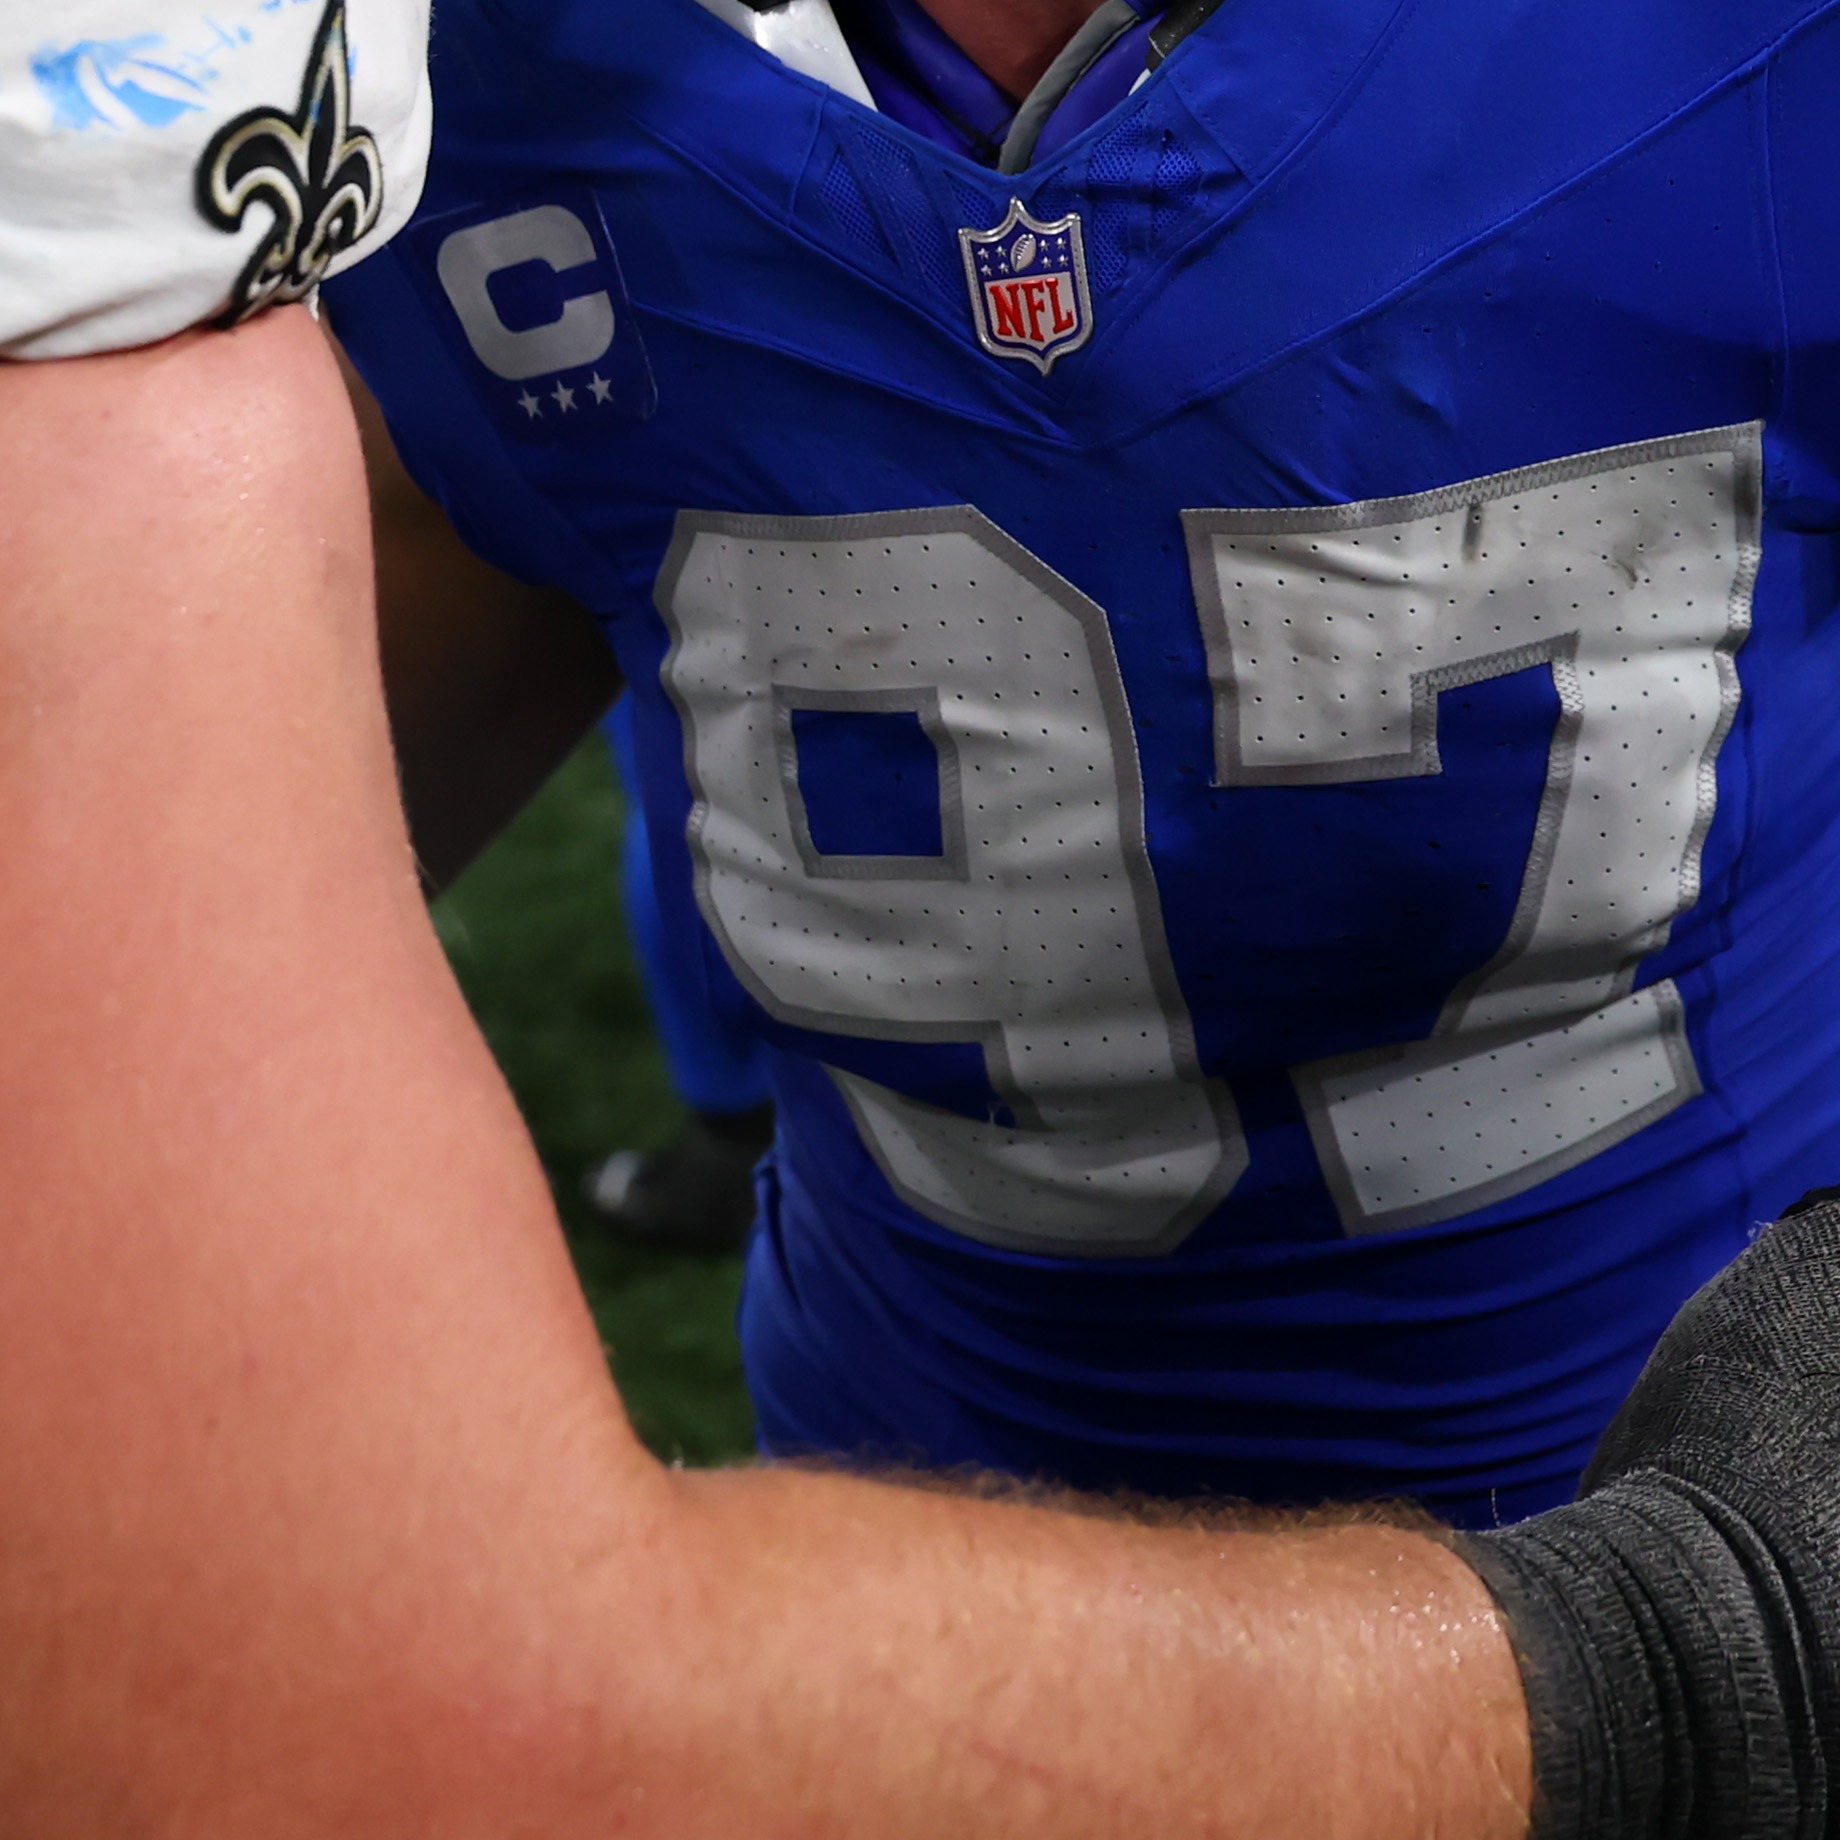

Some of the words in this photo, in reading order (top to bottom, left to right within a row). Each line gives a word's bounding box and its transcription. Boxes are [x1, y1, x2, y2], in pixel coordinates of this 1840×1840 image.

[437, 205, 615, 381] C
[989, 277, 1074, 342] NFL
[652, 421, 1763, 1257] 97
